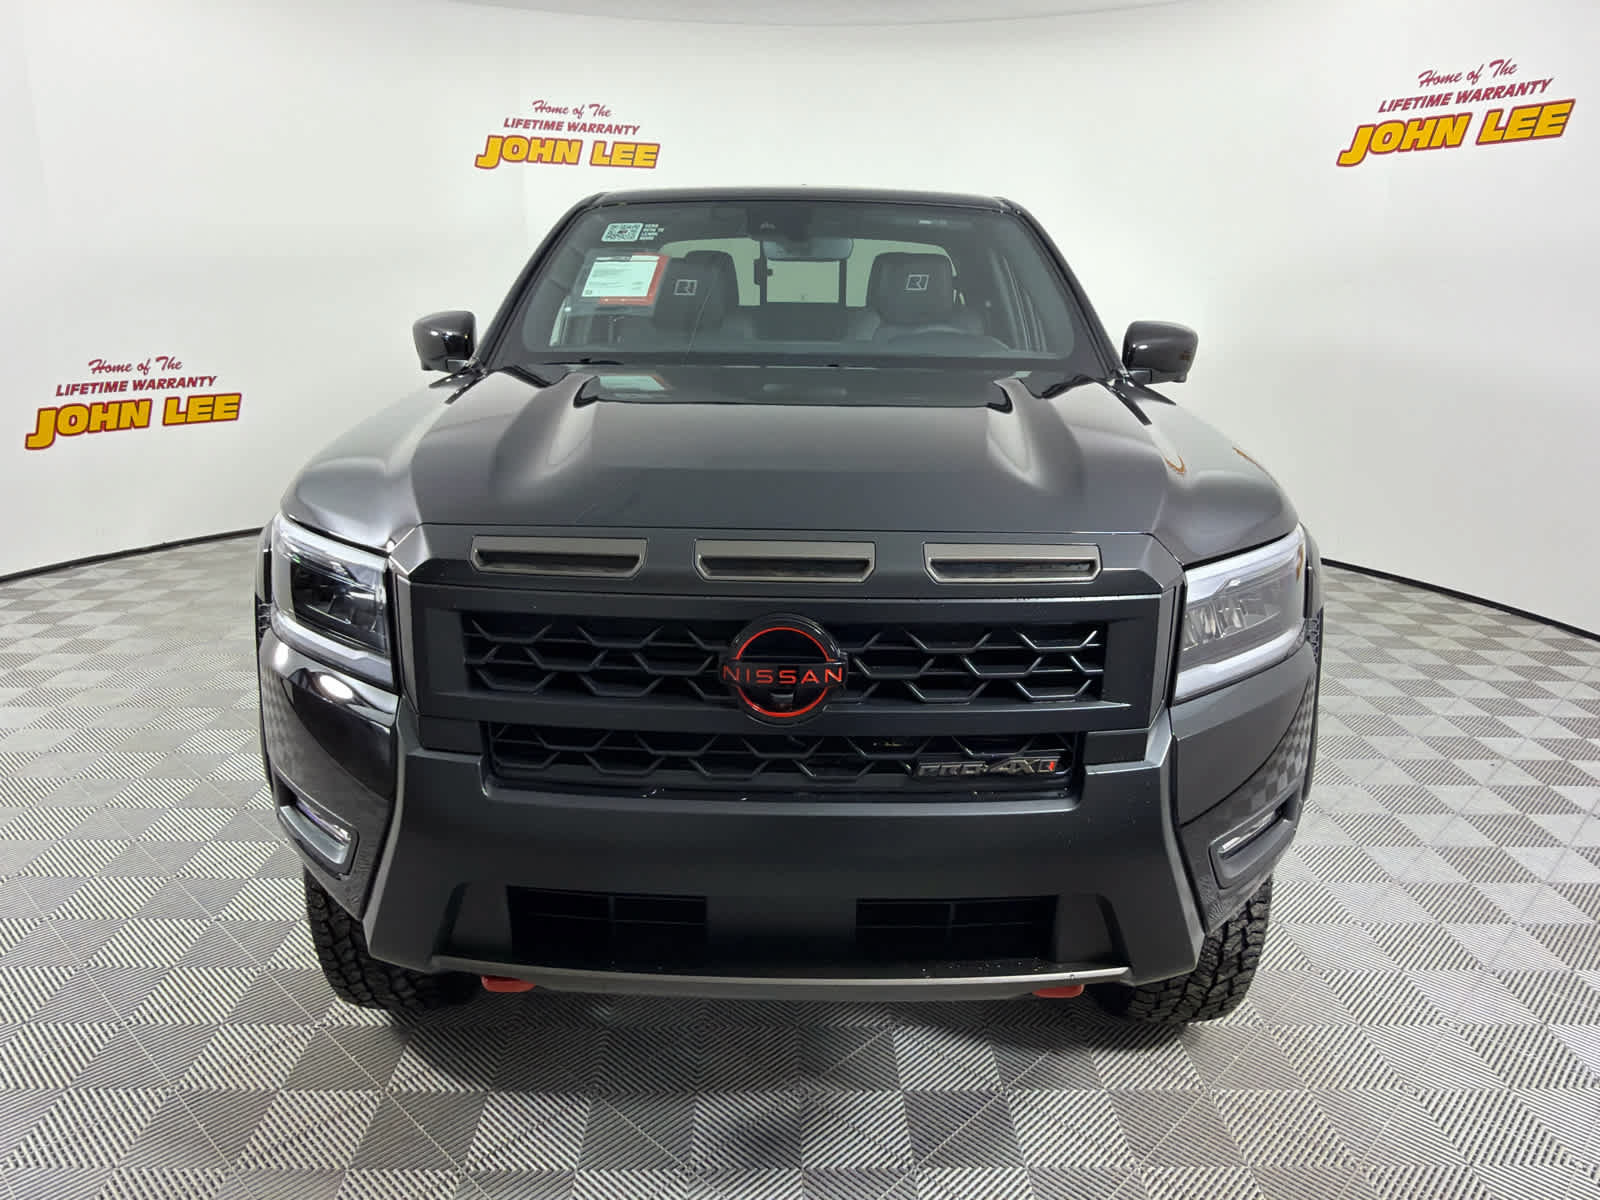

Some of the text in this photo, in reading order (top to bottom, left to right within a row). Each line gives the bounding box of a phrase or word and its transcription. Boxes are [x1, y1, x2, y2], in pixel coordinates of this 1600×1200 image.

[1418, 57, 1518, 88] Home of The
[1378, 78, 1553, 113] LIFETIME WARRANTY
[532, 100, 611, 118] Home of The
[503, 118, 640, 135] LIFETIME WARRANTY
[1336, 98, 1576, 167] JOHN LEE
[474, 135, 660, 169] JOHN LEE
[88, 356, 183, 374] Home of The
[56, 376, 217, 396] LIFETIME WARRANTY
[25, 392, 242, 450] JOHN LEE
[722, 665, 844, 685] NISSAN
